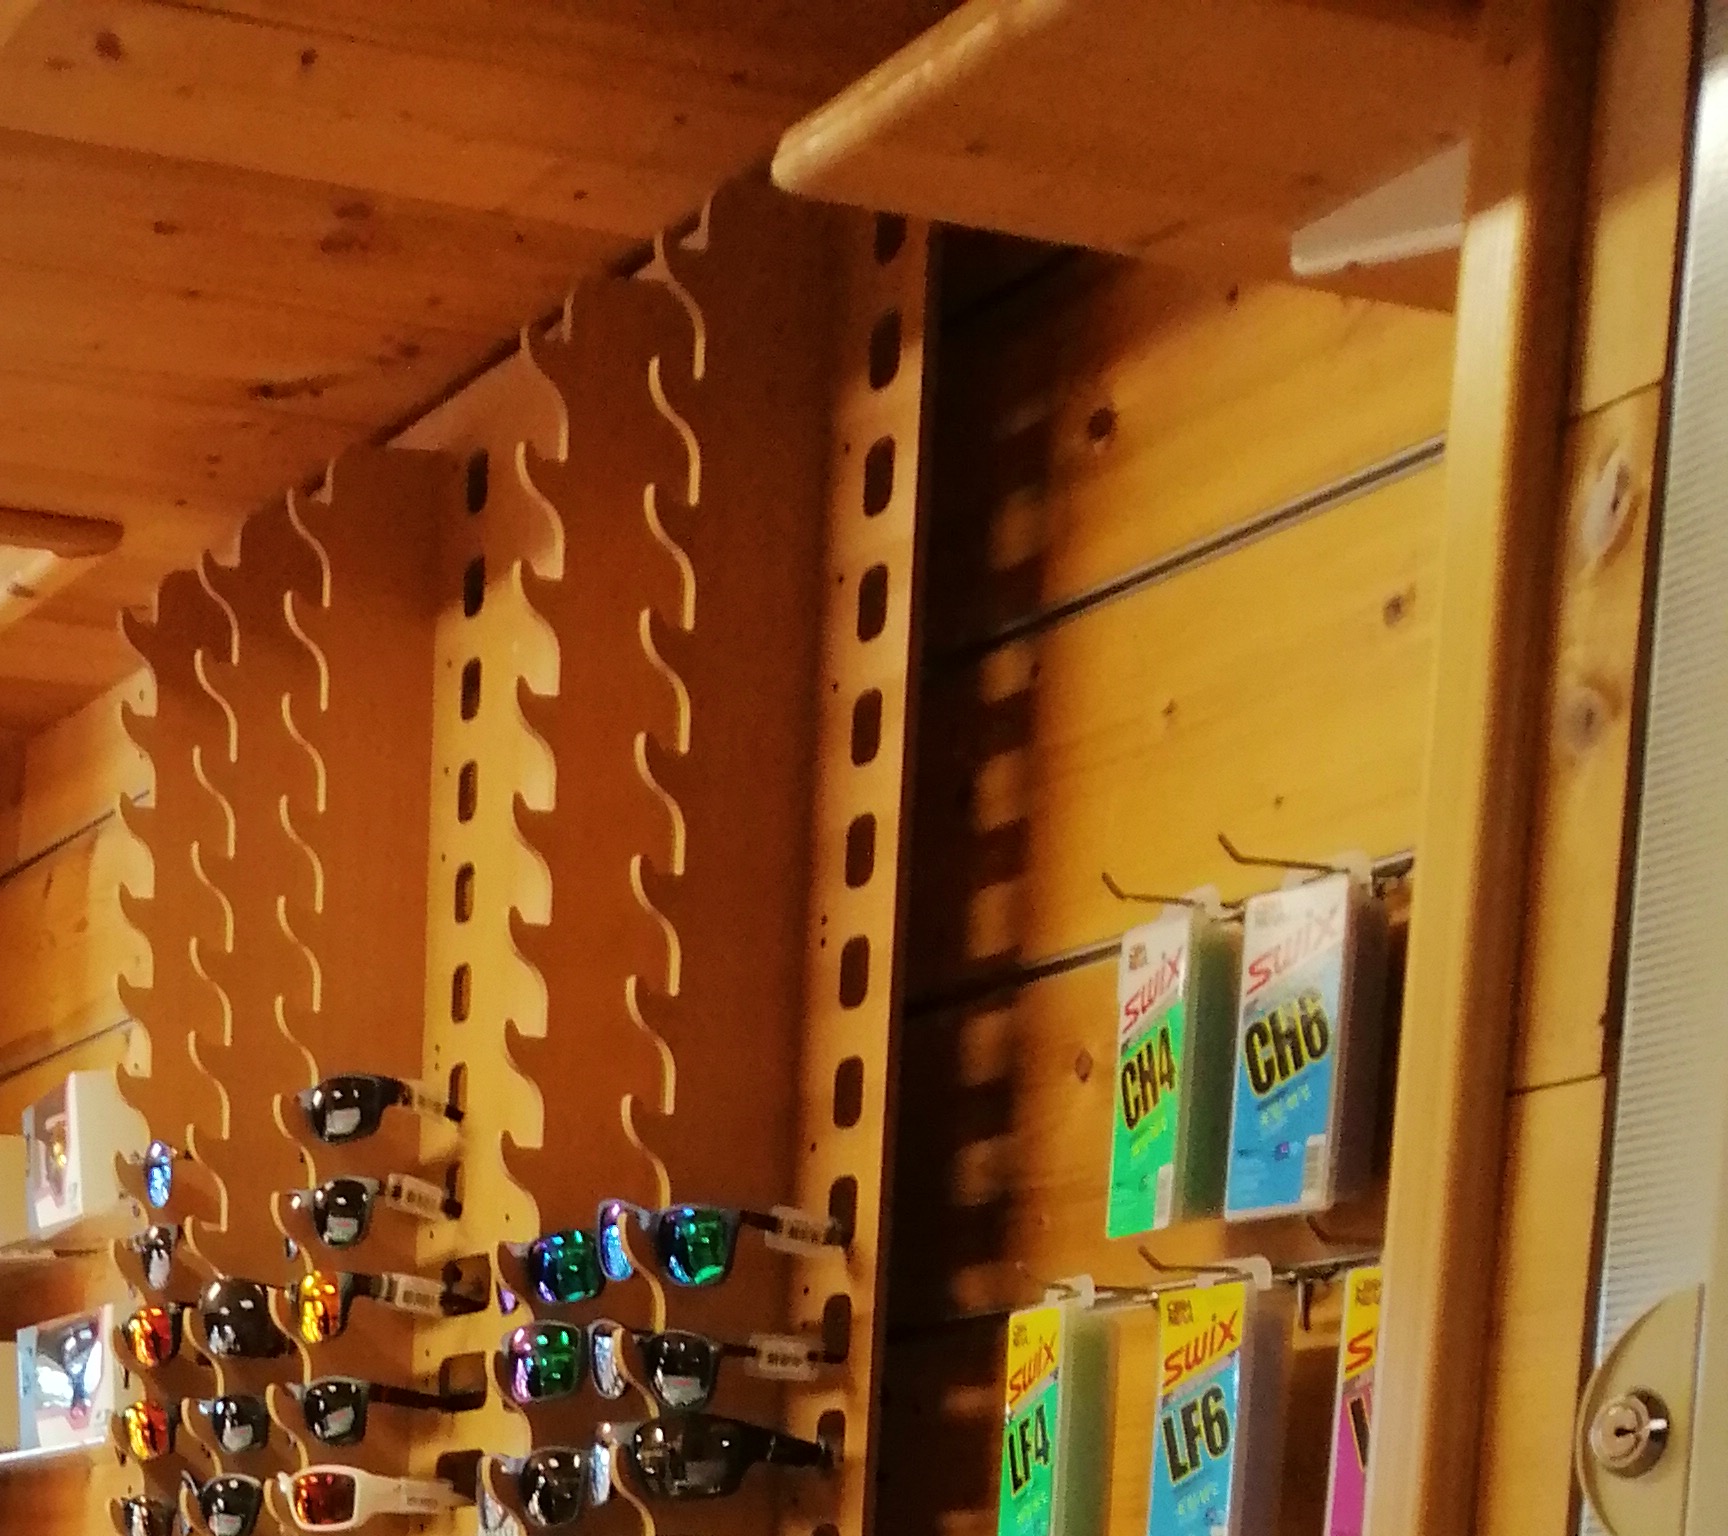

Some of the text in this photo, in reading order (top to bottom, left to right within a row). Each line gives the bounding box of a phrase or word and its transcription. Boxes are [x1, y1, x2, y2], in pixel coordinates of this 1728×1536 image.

[1122, 1025, 1176, 1131] CH4
[1244, 987, 1331, 1096] CH6
[1007, 1403, 1051, 1496] LF4
[1162, 1385, 1231, 1484] LF6
